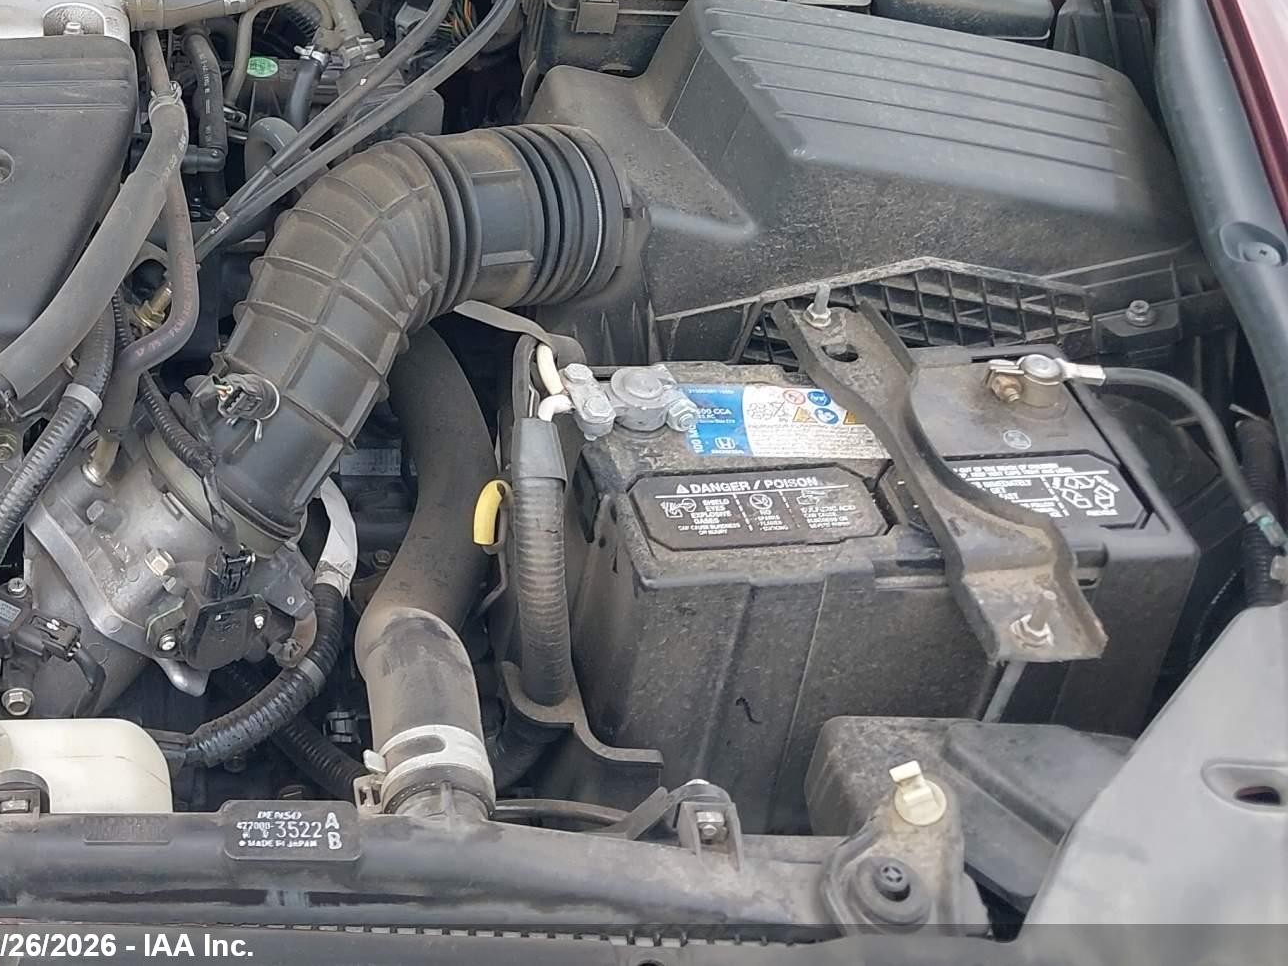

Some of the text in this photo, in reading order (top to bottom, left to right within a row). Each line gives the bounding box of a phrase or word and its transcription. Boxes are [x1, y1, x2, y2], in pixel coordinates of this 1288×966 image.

[690, 480, 749, 494] DANGER
[764, 477, 818, 489] POISON
[257, 810, 302, 819] DENSO
[325, 812, 340, 830] A
[327, 831, 343, 850] B
